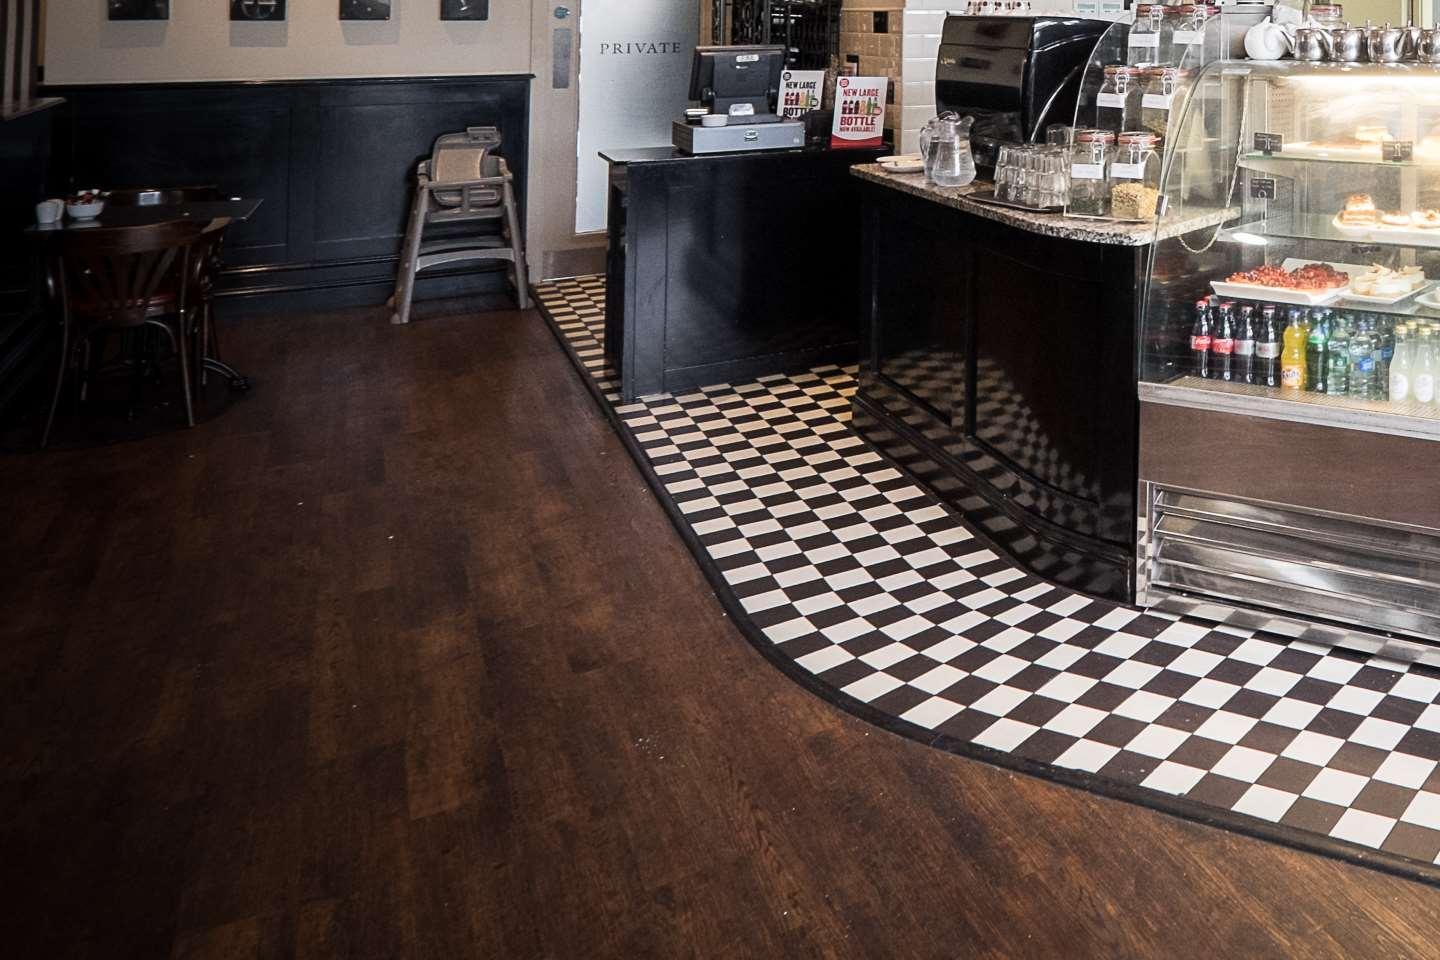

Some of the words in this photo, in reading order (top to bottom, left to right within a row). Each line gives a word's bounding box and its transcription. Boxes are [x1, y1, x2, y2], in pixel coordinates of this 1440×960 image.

[600, 42, 681, 55] PRIVATE
[785, 81, 798, 89] NEW
[799, 81, 816, 90] LARGE
[843, 89, 857, 97] NEW
[859, 88, 879, 97] LARGE
[840, 116, 876, 126] BOTTLE
